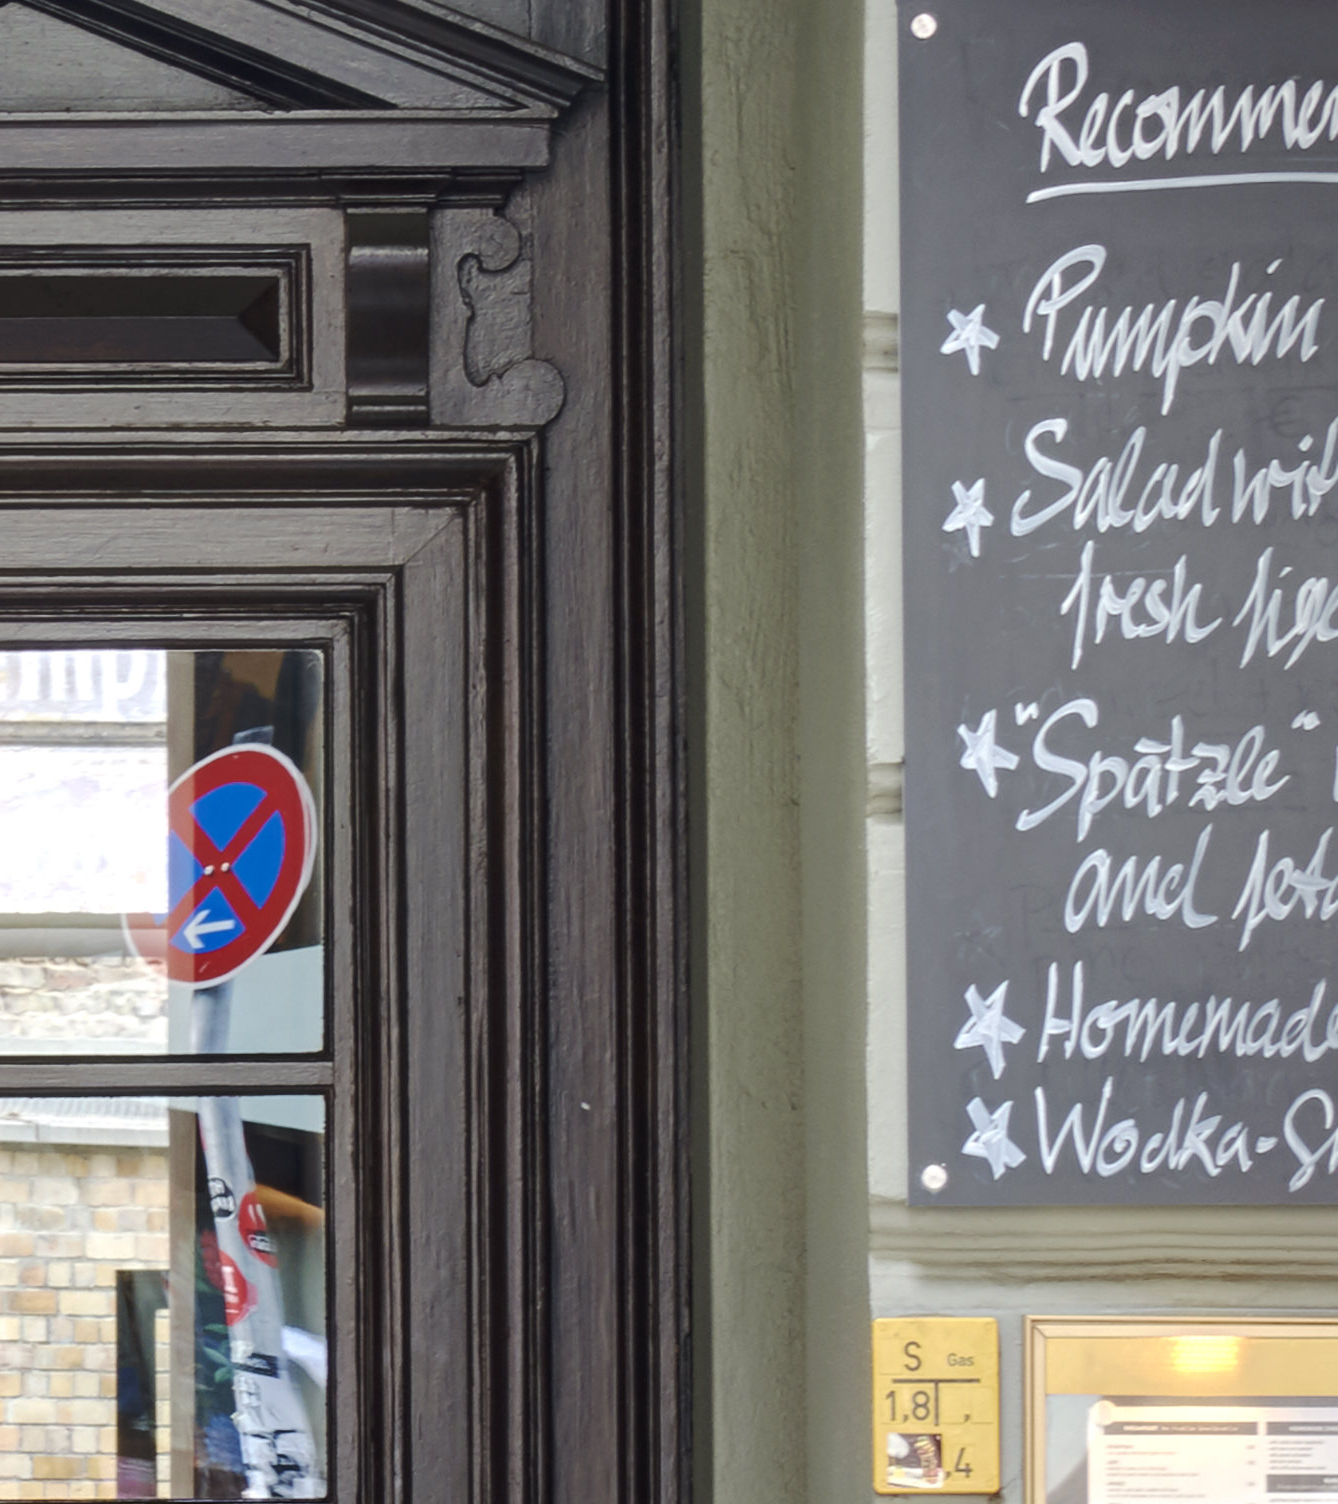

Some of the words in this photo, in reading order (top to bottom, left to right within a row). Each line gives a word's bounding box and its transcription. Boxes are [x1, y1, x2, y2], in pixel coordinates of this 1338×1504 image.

[1023, 244, 1325, 416] Pumpkin
[1011, 417, 1222, 537] Salad
[1060, 540, 1223, 670] fresh
[1064, 823, 1219, 933] and
[885, 1390, 931, 1422] 1,8
[903, 1341, 922, 1371] S
[946, 1353, 974, 1367] Gas
